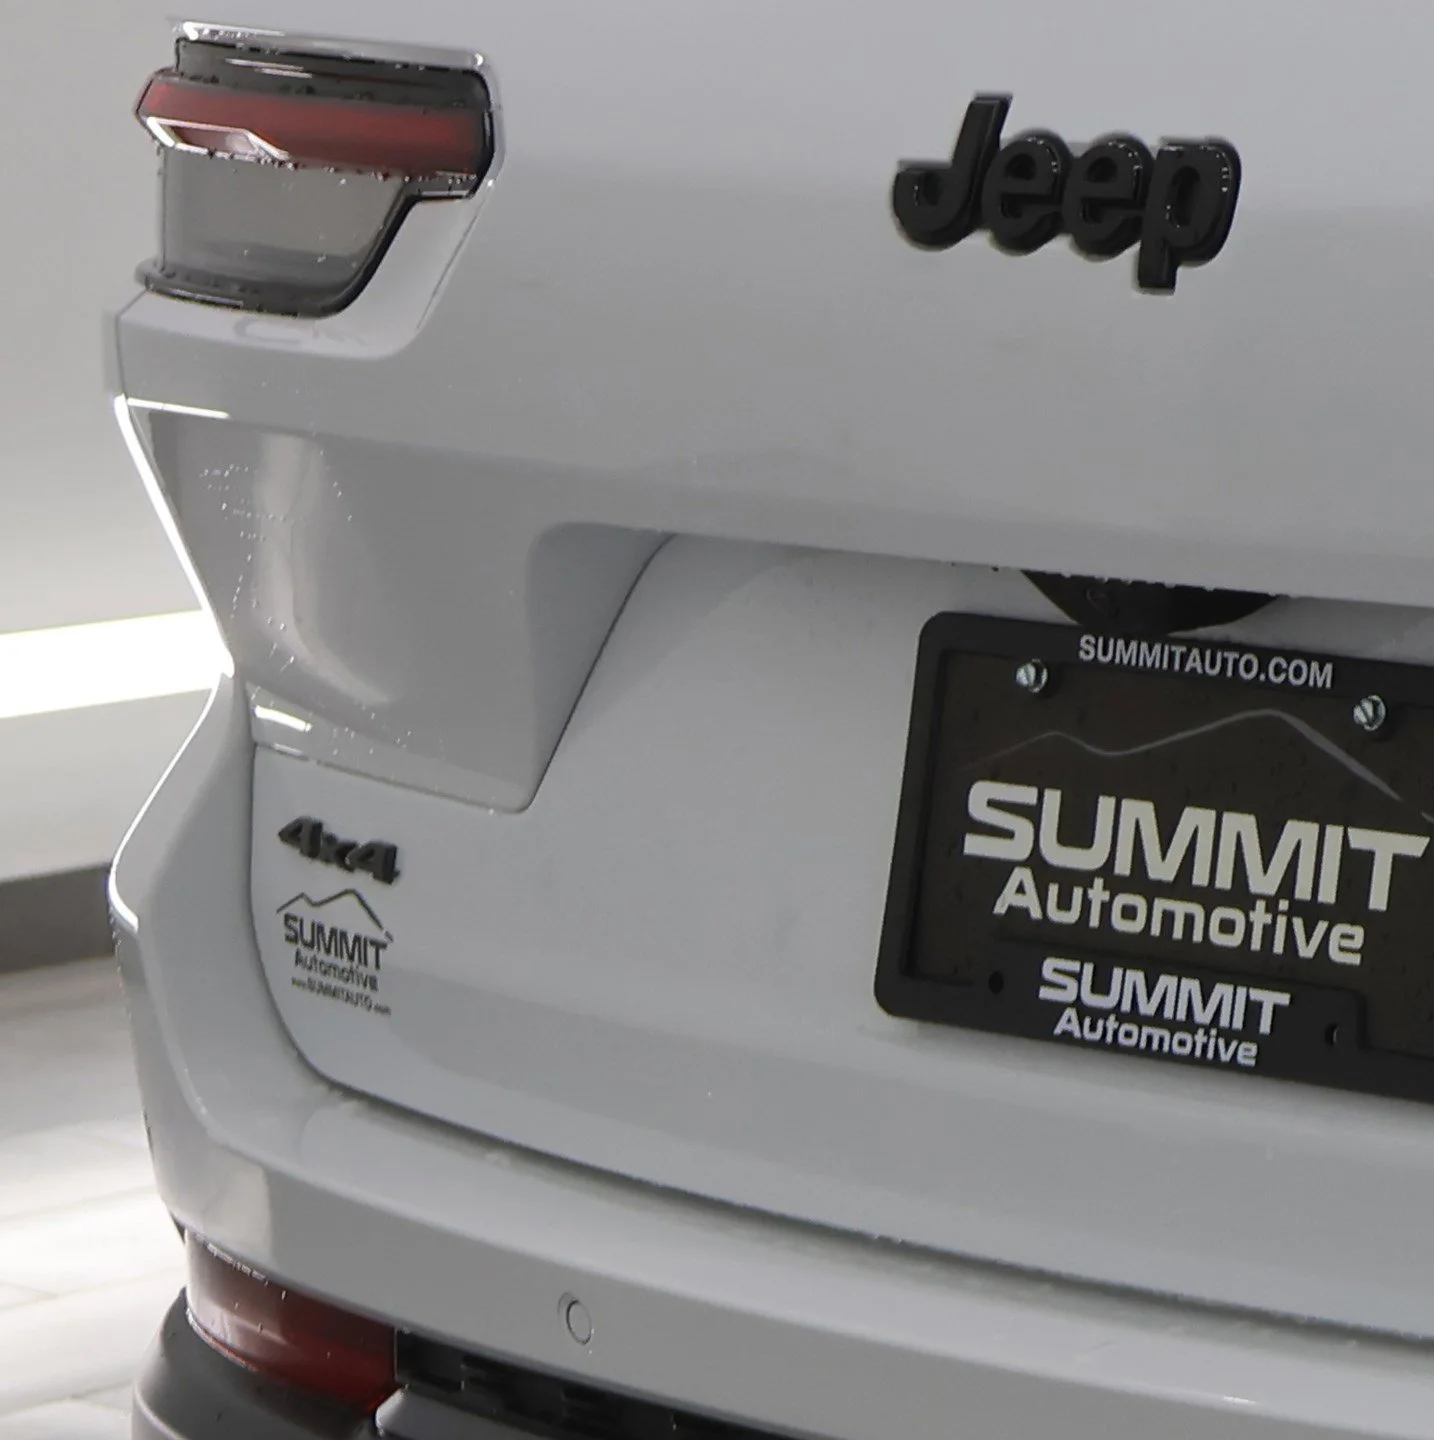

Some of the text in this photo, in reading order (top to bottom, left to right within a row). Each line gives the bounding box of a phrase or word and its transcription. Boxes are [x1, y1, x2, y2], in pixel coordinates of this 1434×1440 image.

[892, 92, 1242, 296] Jeep
[1078, 634, 1334, 690] SUMMITAUTO.COM
[963, 779, 1430, 912] SUMMIT
[284, 912, 388, 971] SUMMIT
[993, 866, 1366, 966] Automotive
[1038, 957, 1291, 1035] SUMMIT
[1053, 1006, 1259, 1067] Automotive
